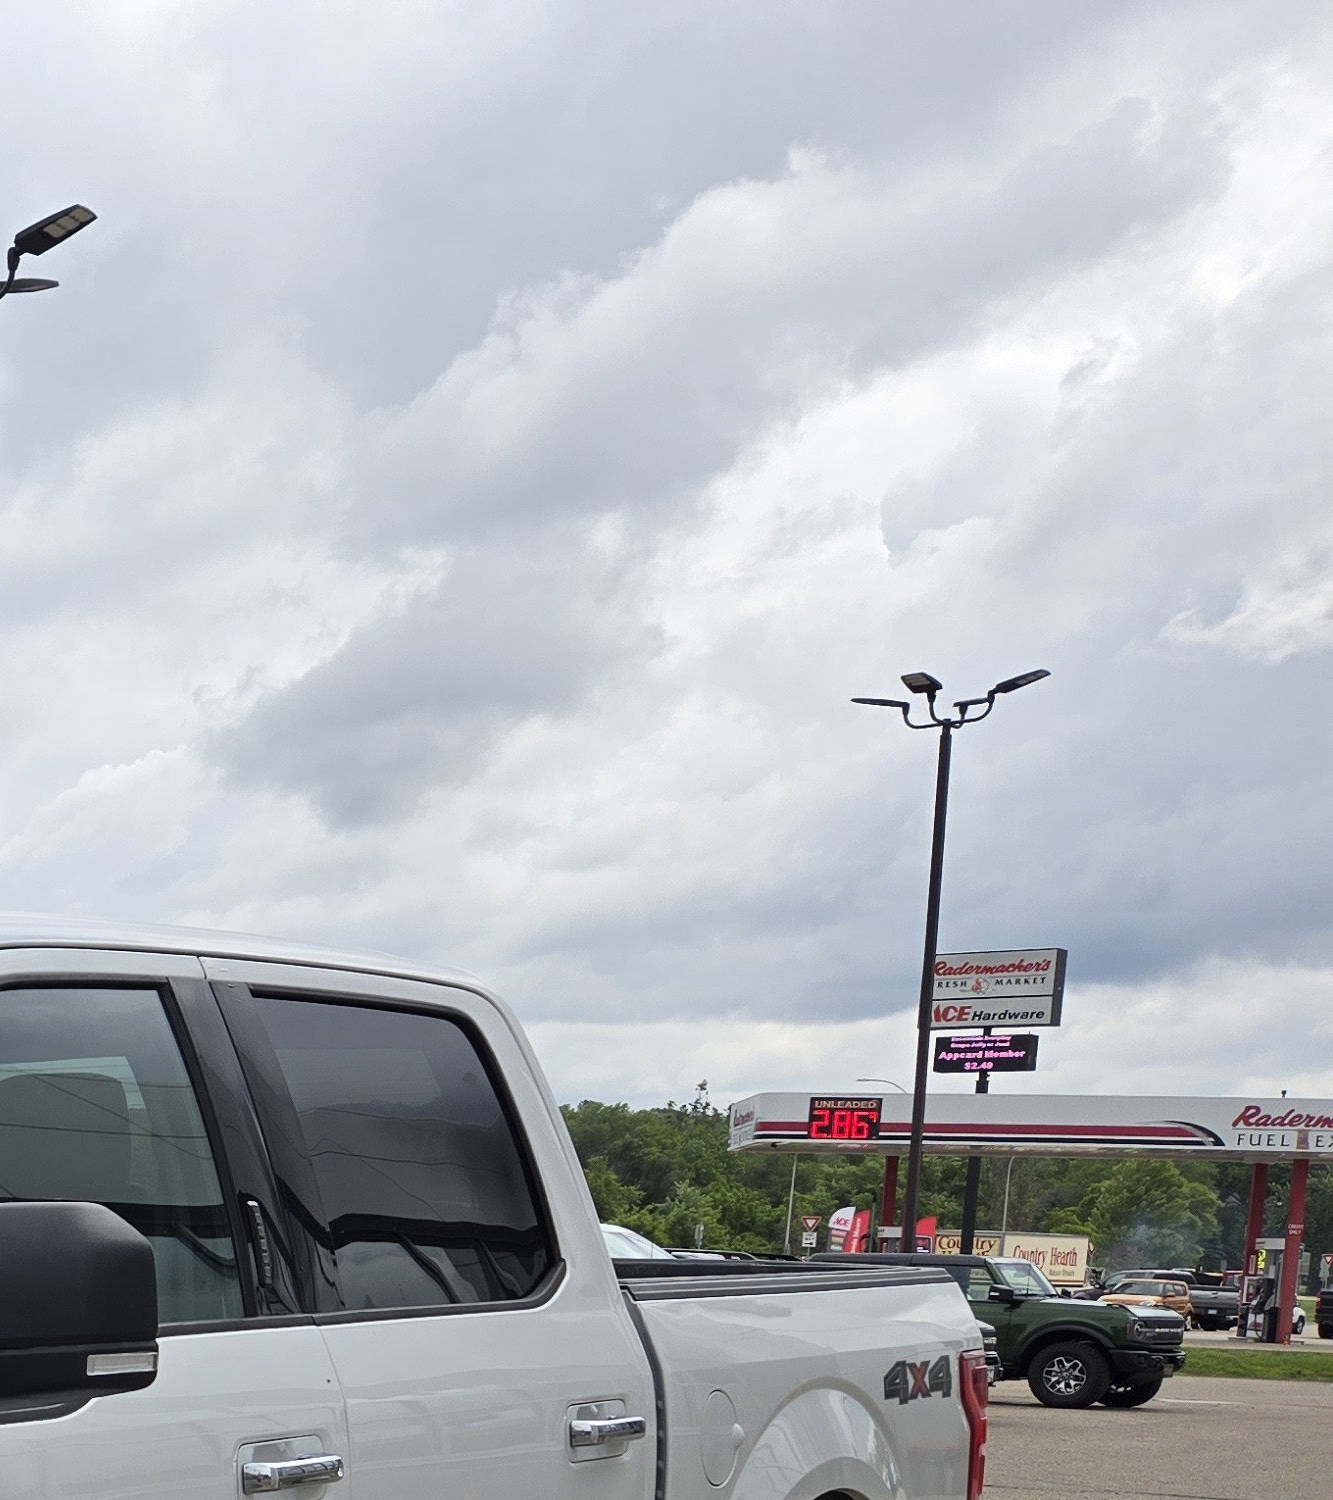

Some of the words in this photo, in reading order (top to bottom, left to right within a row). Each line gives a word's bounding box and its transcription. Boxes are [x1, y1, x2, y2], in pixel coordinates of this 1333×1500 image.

[934, 959, 1052, 977] Radermacher's
[994, 977, 1046, 986] MARKET
[971, 1010, 1045, 1022] Hardware
[984, 1050, 1026, 1058] Member
[815, 1100, 877, 1109] UNLEADED
[1237, 1133, 1290, 1147] FUEL
[938, 1236, 996, 1253] Coutry
[1051, 1248, 1078, 1267] Hearth
